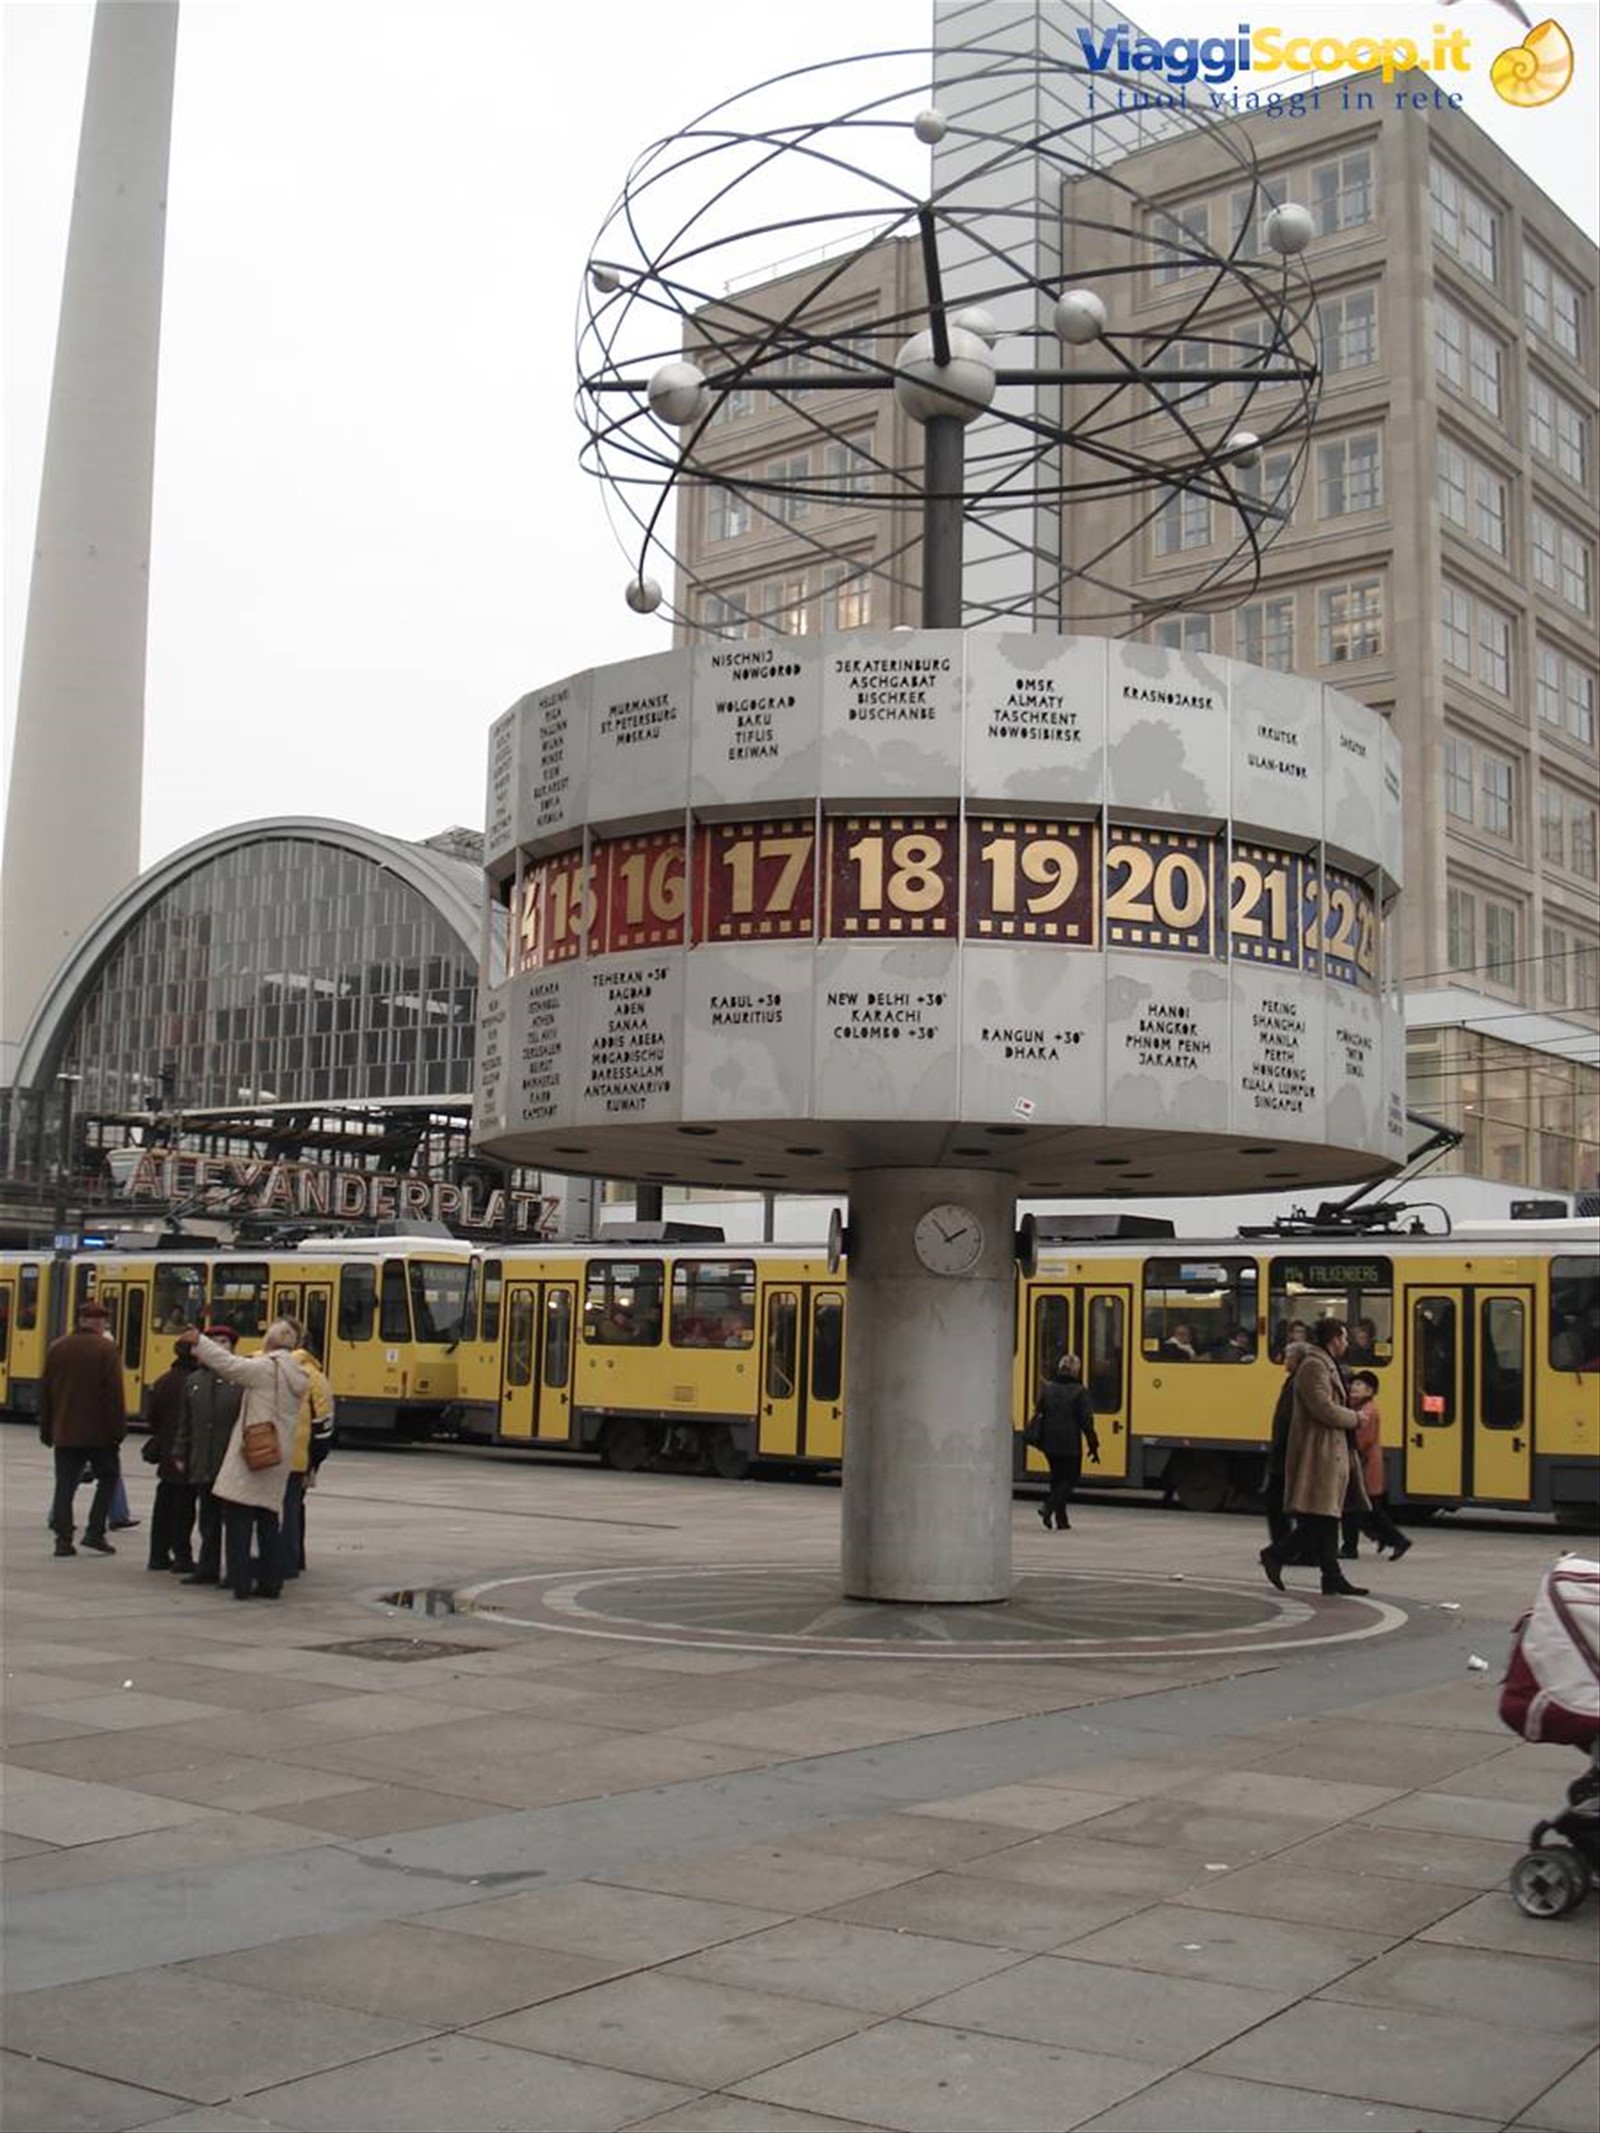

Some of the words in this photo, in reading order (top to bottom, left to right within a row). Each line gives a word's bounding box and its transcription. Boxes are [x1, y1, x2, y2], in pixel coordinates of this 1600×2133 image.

[711, 650, 773, 668] NISCHNIJ
[836, 659, 950, 673] JEKATERINBURG
[733, 664, 800, 681] NOWGOROD
[850, 676, 937, 688] ASCHGABAT
[1016, 679, 1055, 692] OMSK
[608, 694, 669, 716] MURMANSK
[715, 697, 795, 714] WOLGOGRAD
[858, 692, 926, 704] BISCHKEK
[1007, 696, 1064, 709] ALMATY
[1123, 686, 1213, 711] KRASNOJARSK
[738, 714, 772, 727] BAKU
[850, 708, 936, 720] DUSCHANBE
[994, 709, 1077, 726] TASCHKENT
[616, 728, 660, 747] MOSKAU
[735, 729, 773, 743] TIFLIS
[988, 725, 1081, 742] NOWOSIBIRSK
[728, 744, 778, 760] ERIWAN
[723, 836, 814, 914] 17
[849, 834, 944, 912] 18
[981, 839, 1079, 914] 19
[620, 850, 687, 924] 16
[1106, 845, 1206, 929] 20
[551, 867, 598, 941] 15
[1229, 861, 1287, 941] 21
[1305, 880, 1355, 961] 22
[593, 970, 642, 987] TEHERAN
[609, 986, 651, 1000] BAGDAD
[827, 993, 858, 1006] NEW
[867, 993, 910, 1006] DELHI
[614, 1003, 645, 1015] ADEN
[710, 996, 753, 1009] KABUL
[1262, 999, 1297, 1016] PEKING
[712, 1010, 783, 1026] MAURITIUS
[851, 1010, 921, 1022] KARACHI
[1148, 1003, 1190, 1019] HANOI
[609, 1019, 648, 1032] SANAA
[1139, 1019, 1198, 1036] BANGKOK
[1252, 1014, 1305, 1033] SHANGHAI
[834, 1026, 900, 1039] COLOMBO
[981, 1028, 1045, 1043] RANGUN
[1259, 1031, 1298, 1048] MANILA
[593, 1036, 624, 1049] ADDIS
[630, 1033, 665, 1046] ABEBA
[1125, 1035, 1171, 1050] PHNOM
[1178, 1039, 1211, 1052] PENH
[592, 1050, 664, 1065] MOGADISCHU
[1005, 1047, 1059, 1061] DHAKA
[1139, 1053, 1198, 1069] JAKARTA
[1264, 1048, 1294, 1063] PERTH
[592, 1066, 663, 1081] DARESSALAM
[1252, 1062, 1306, 1081] HONGKONG
[584, 1081, 671, 1097] ANTANANARIVO
[1242, 1077, 1274, 1092] KUALA
[1278, 1082, 1315, 1098] LUMPUR
[606, 1098, 646, 1111] KUWAIT
[1254, 1095, 1303, 1113] SINGAPUR
[124, 1152, 560, 1236] ALEXANDERPLATZ
